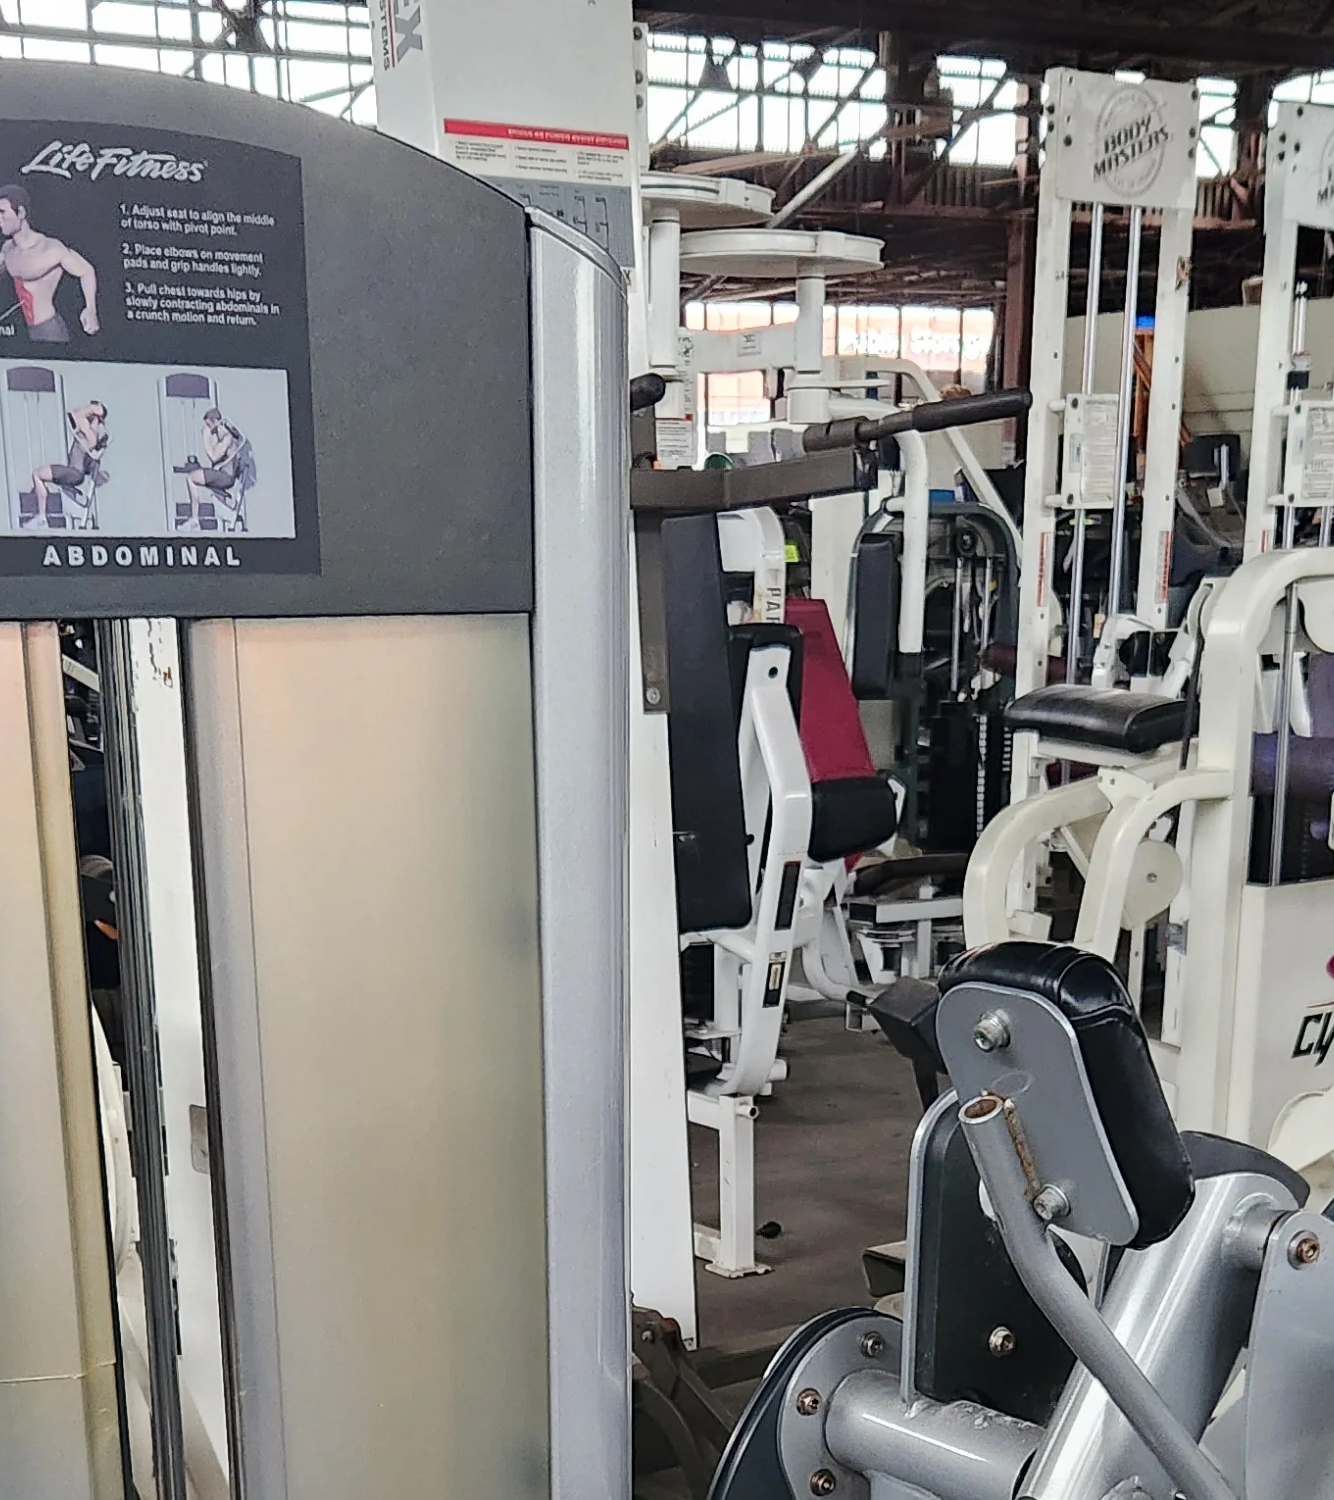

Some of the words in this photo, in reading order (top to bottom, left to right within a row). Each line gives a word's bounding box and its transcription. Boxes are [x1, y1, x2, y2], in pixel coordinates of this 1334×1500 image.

[21, 140, 94, 179] Life
[90, 147, 205, 182] Fitness
[120, 204, 129, 214] 1.
[132, 205, 164, 218] Adjust
[167, 210, 187, 218] seat
[190, 211, 199, 219] to
[202, 212, 225, 223] align
[227, 213, 241, 221] the
[244, 214, 274, 225] middle
[121, 219, 131, 227] of
[134, 220, 159, 229] torso
[162, 221, 182, 231] with
[185, 224, 209, 234] pivot
[211, 226, 237, 235] point.
[122, 243, 132, 254] 2.
[135, 244, 161, 255] Place
[164, 246, 198, 258] elbows
[201, 251, 212, 259] on
[215, 252, 263, 263] movement
[124, 259, 147, 269] pads
[150, 261, 169, 269] and
[171, 262, 190, 272] grip
[192, 262, 229, 273] handles
[231, 264, 261, 276] lightly.
[126, 283, 134, 293] 3.
[138, 284, 156, 294] Pull
[159, 286, 185, 295] chest
[188, 288, 224, 297] towards
[227, 289, 246, 300] hips
[249, 290, 260, 302] by
[126, 297, 157, 309] slowly
[160, 299, 214, 311] contracting
[216, 302, 268, 313] abdominals
[271, 304, 279, 314] in
[136, 311, 168, 321] crunch
[172, 313, 204, 322] motion
[207, 315, 224, 323] and
[227, 316, 256, 325] return.
[43, 545, 241, 567] ABDOMINAL
